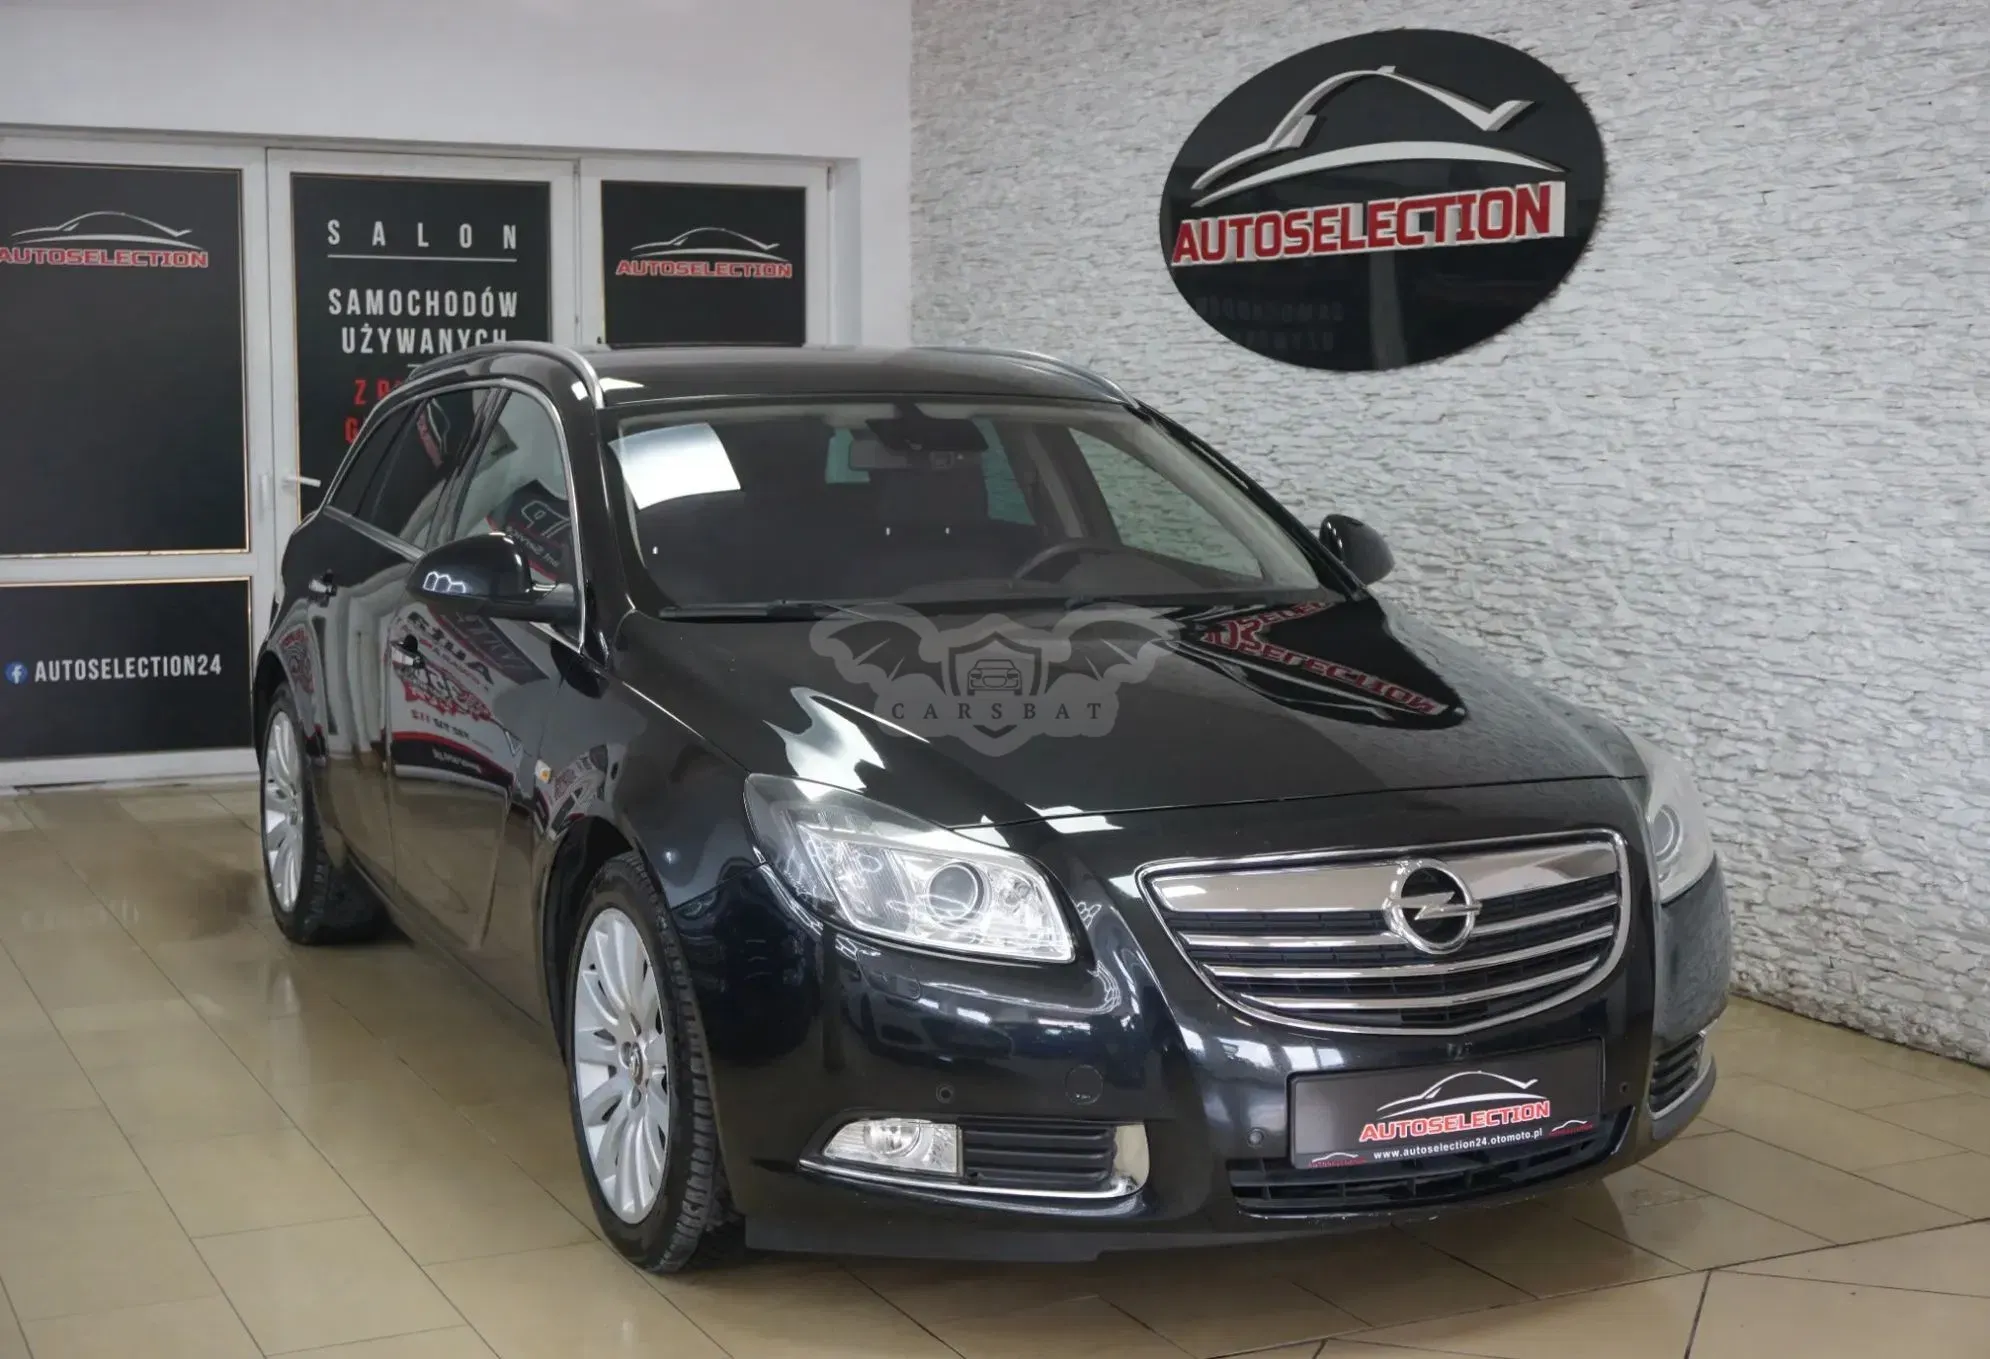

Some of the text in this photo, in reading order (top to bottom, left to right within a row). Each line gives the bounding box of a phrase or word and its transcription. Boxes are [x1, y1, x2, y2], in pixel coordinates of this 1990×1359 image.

[327, 219, 517, 250] SALON
[1170, 180, 1566, 267] AUTOSELECTION
[0, 247, 208, 268] AUTOSELECTION
[615, 260, 793, 279] AUTOSELECTION
[328, 286, 518, 317] SAMOCHODÓW
[34, 653, 222, 683] AUTOSELECTION24
[1358, 1099, 1551, 1143] AUTOSELECTION
[1373, 1127, 1544, 1160] www.autoselection24.otomoto.pl
